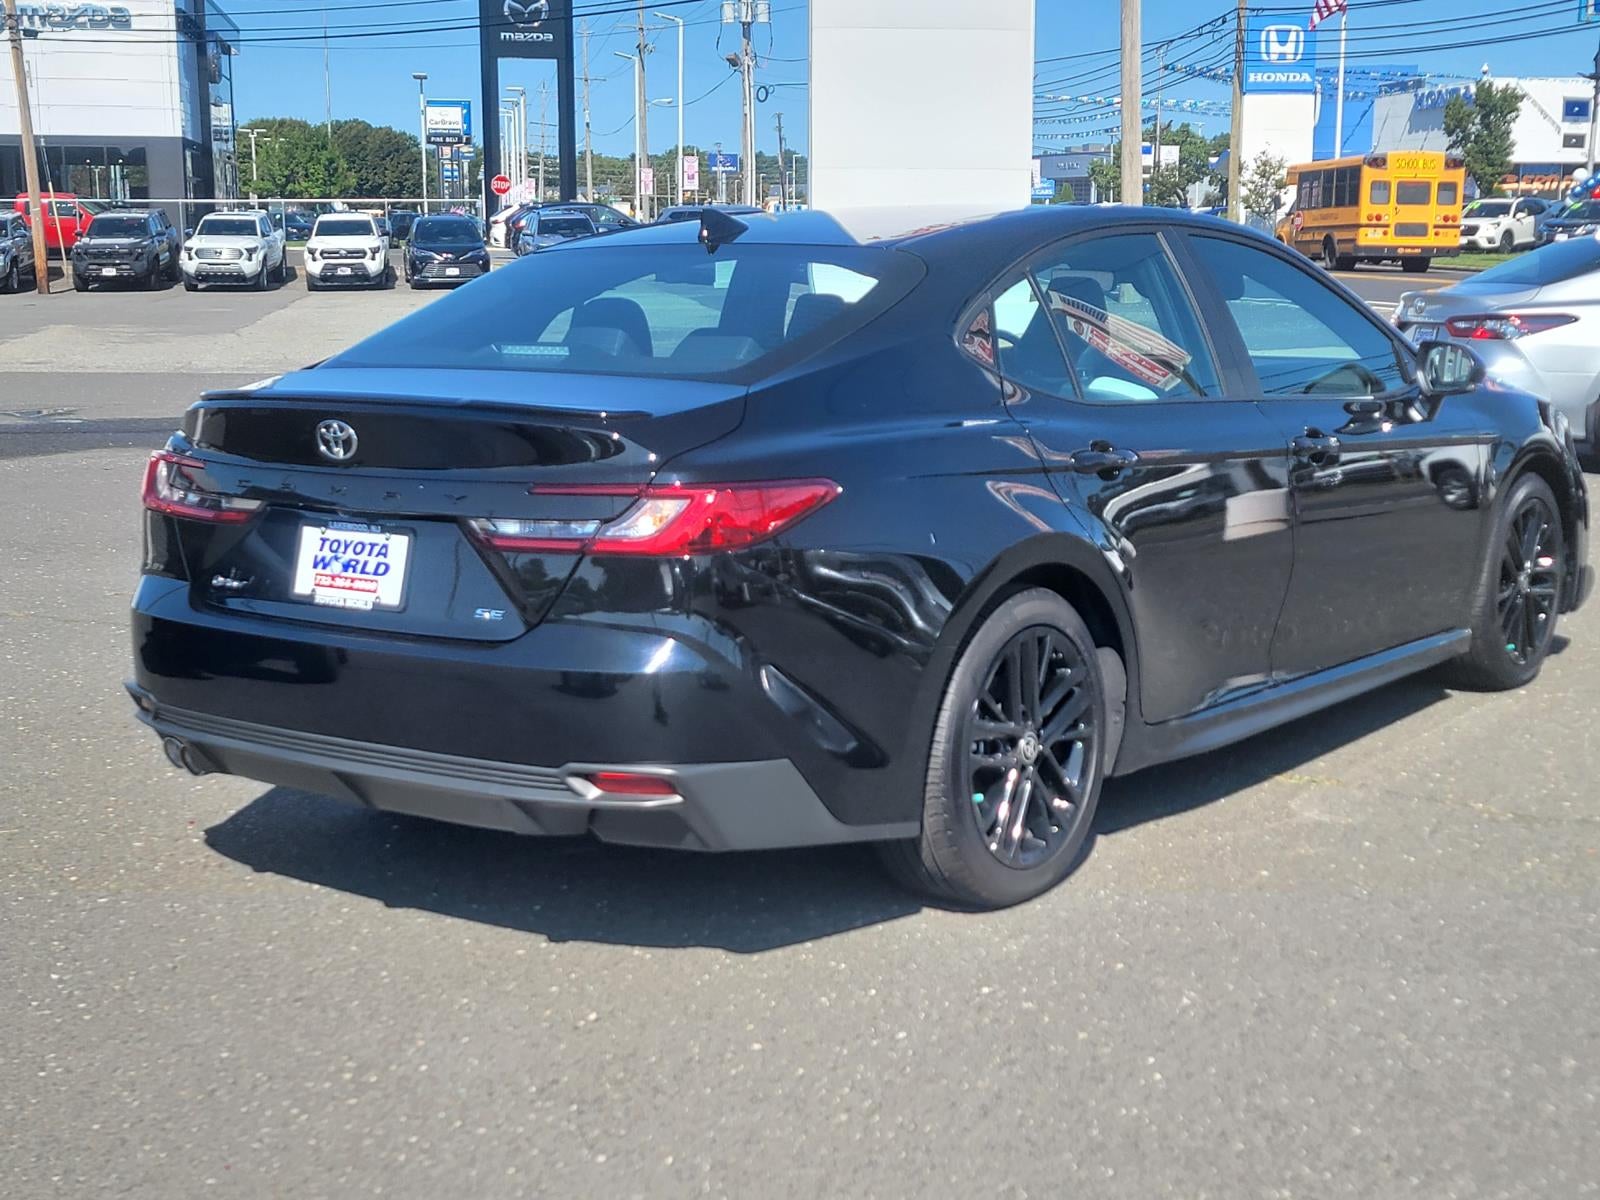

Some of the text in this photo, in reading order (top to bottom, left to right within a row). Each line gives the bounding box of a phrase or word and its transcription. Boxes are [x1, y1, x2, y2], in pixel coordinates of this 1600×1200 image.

[500, 31, 554, 41] mazda
[1248, 72, 1313, 82] HONDA
[1422, 159, 1436, 169] BUS
[493, 181, 510, 190] STOP
[319, 537, 389, 558] TOYOTA
[312, 554, 391, 577] WORLD
[474, 608, 506, 620] SE
